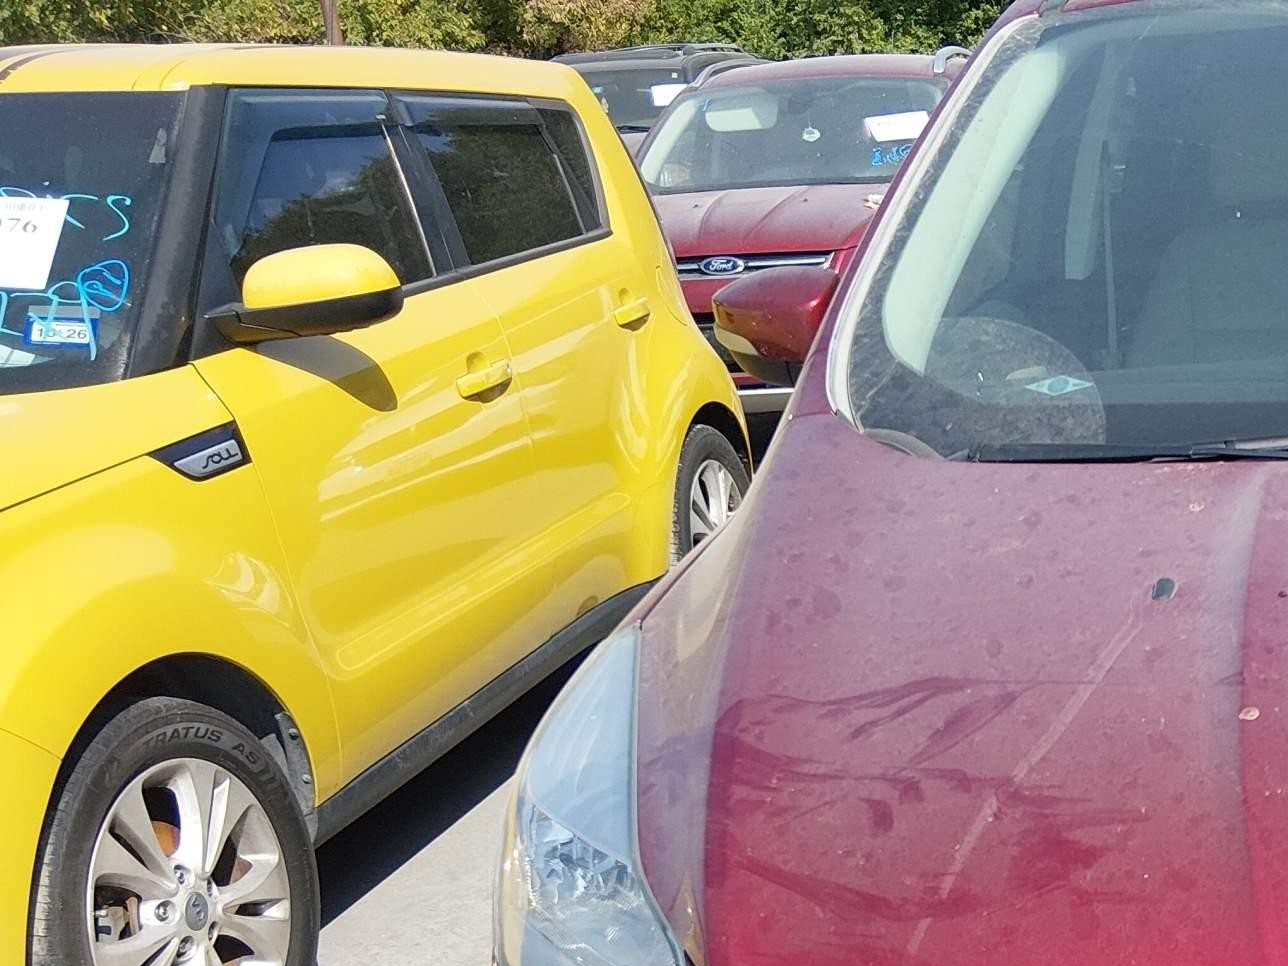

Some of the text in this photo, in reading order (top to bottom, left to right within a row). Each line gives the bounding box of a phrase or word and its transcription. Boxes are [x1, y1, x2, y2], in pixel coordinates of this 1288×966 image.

[0, 218, 38, 233] 76
[709, 259, 734, 271] Ford
[66, 328, 87, 339] 26
[138, 726, 224, 751] TRATUS
